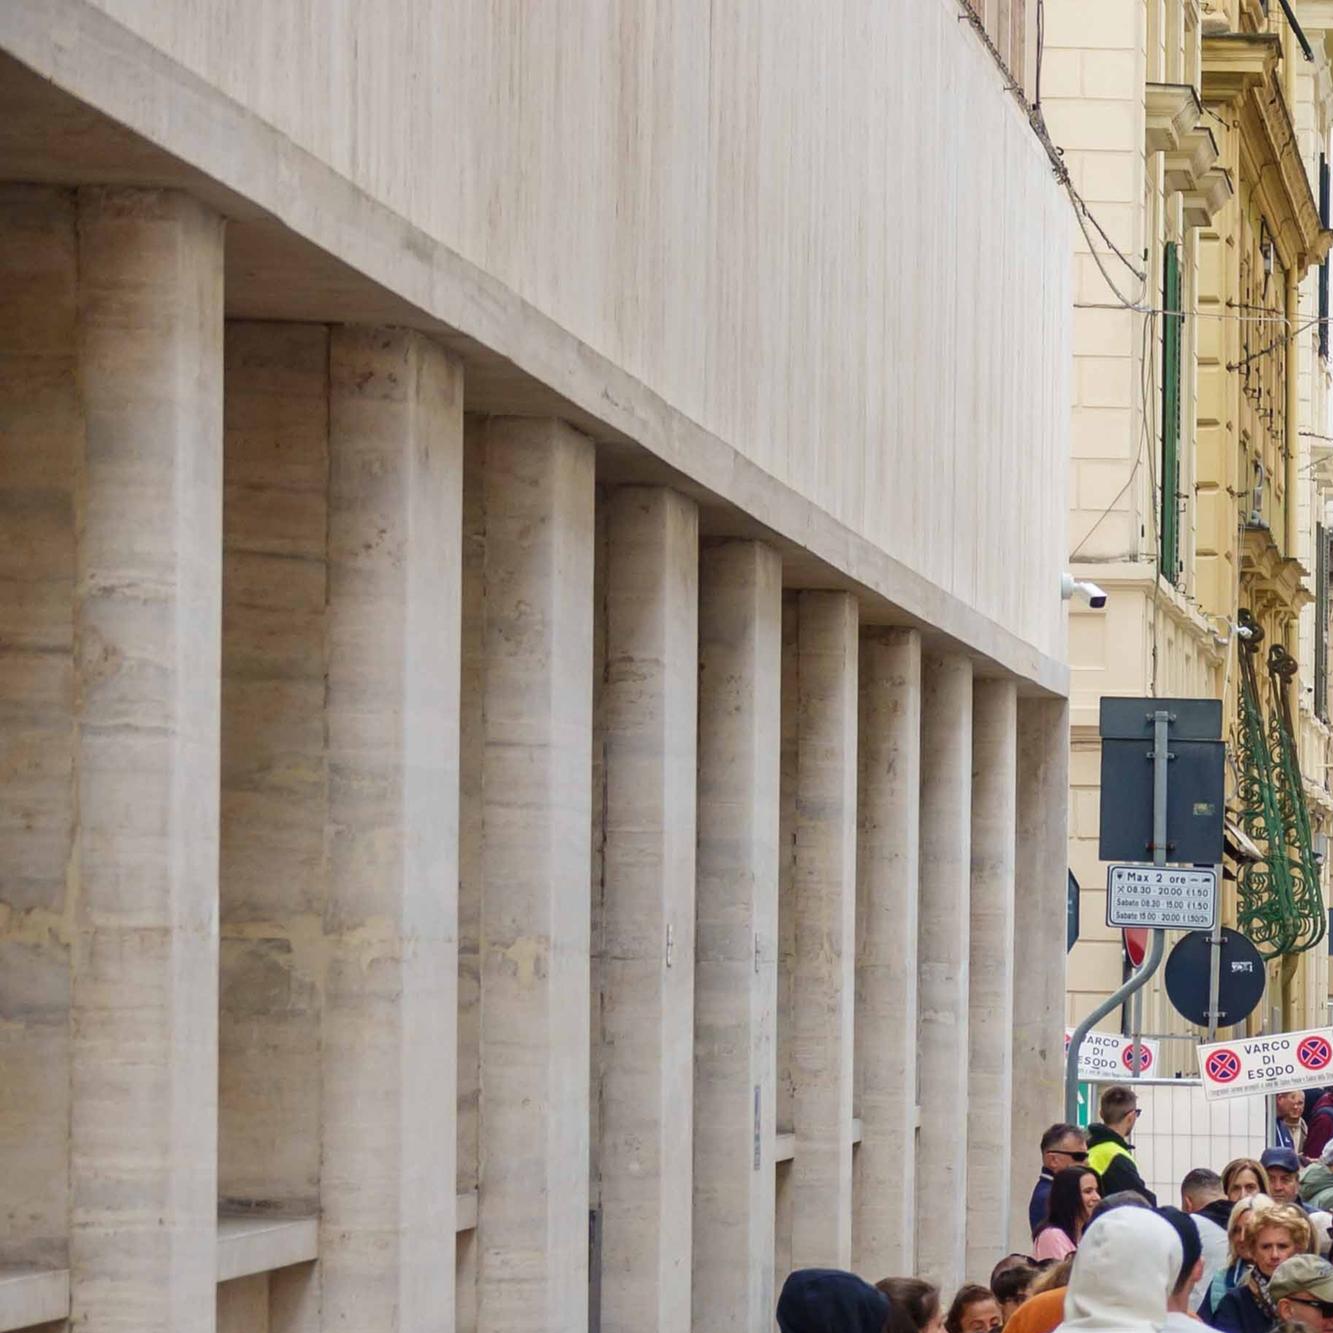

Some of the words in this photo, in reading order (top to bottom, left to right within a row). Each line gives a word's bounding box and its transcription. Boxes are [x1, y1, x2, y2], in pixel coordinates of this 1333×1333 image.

[1127, 872, 1149, 882] Max
[1156, 873, 1162, 882] 2
[1169, 875, 1186, 884] ore
[1086, 1035, 1119, 1048] ARCO
[1244, 1040, 1290, 1054] VARCO
[1092, 1047, 1104, 1056] DI
[1262, 1055, 1275, 1065] DI
[1248, 1064, 1295, 1080] ESODO
